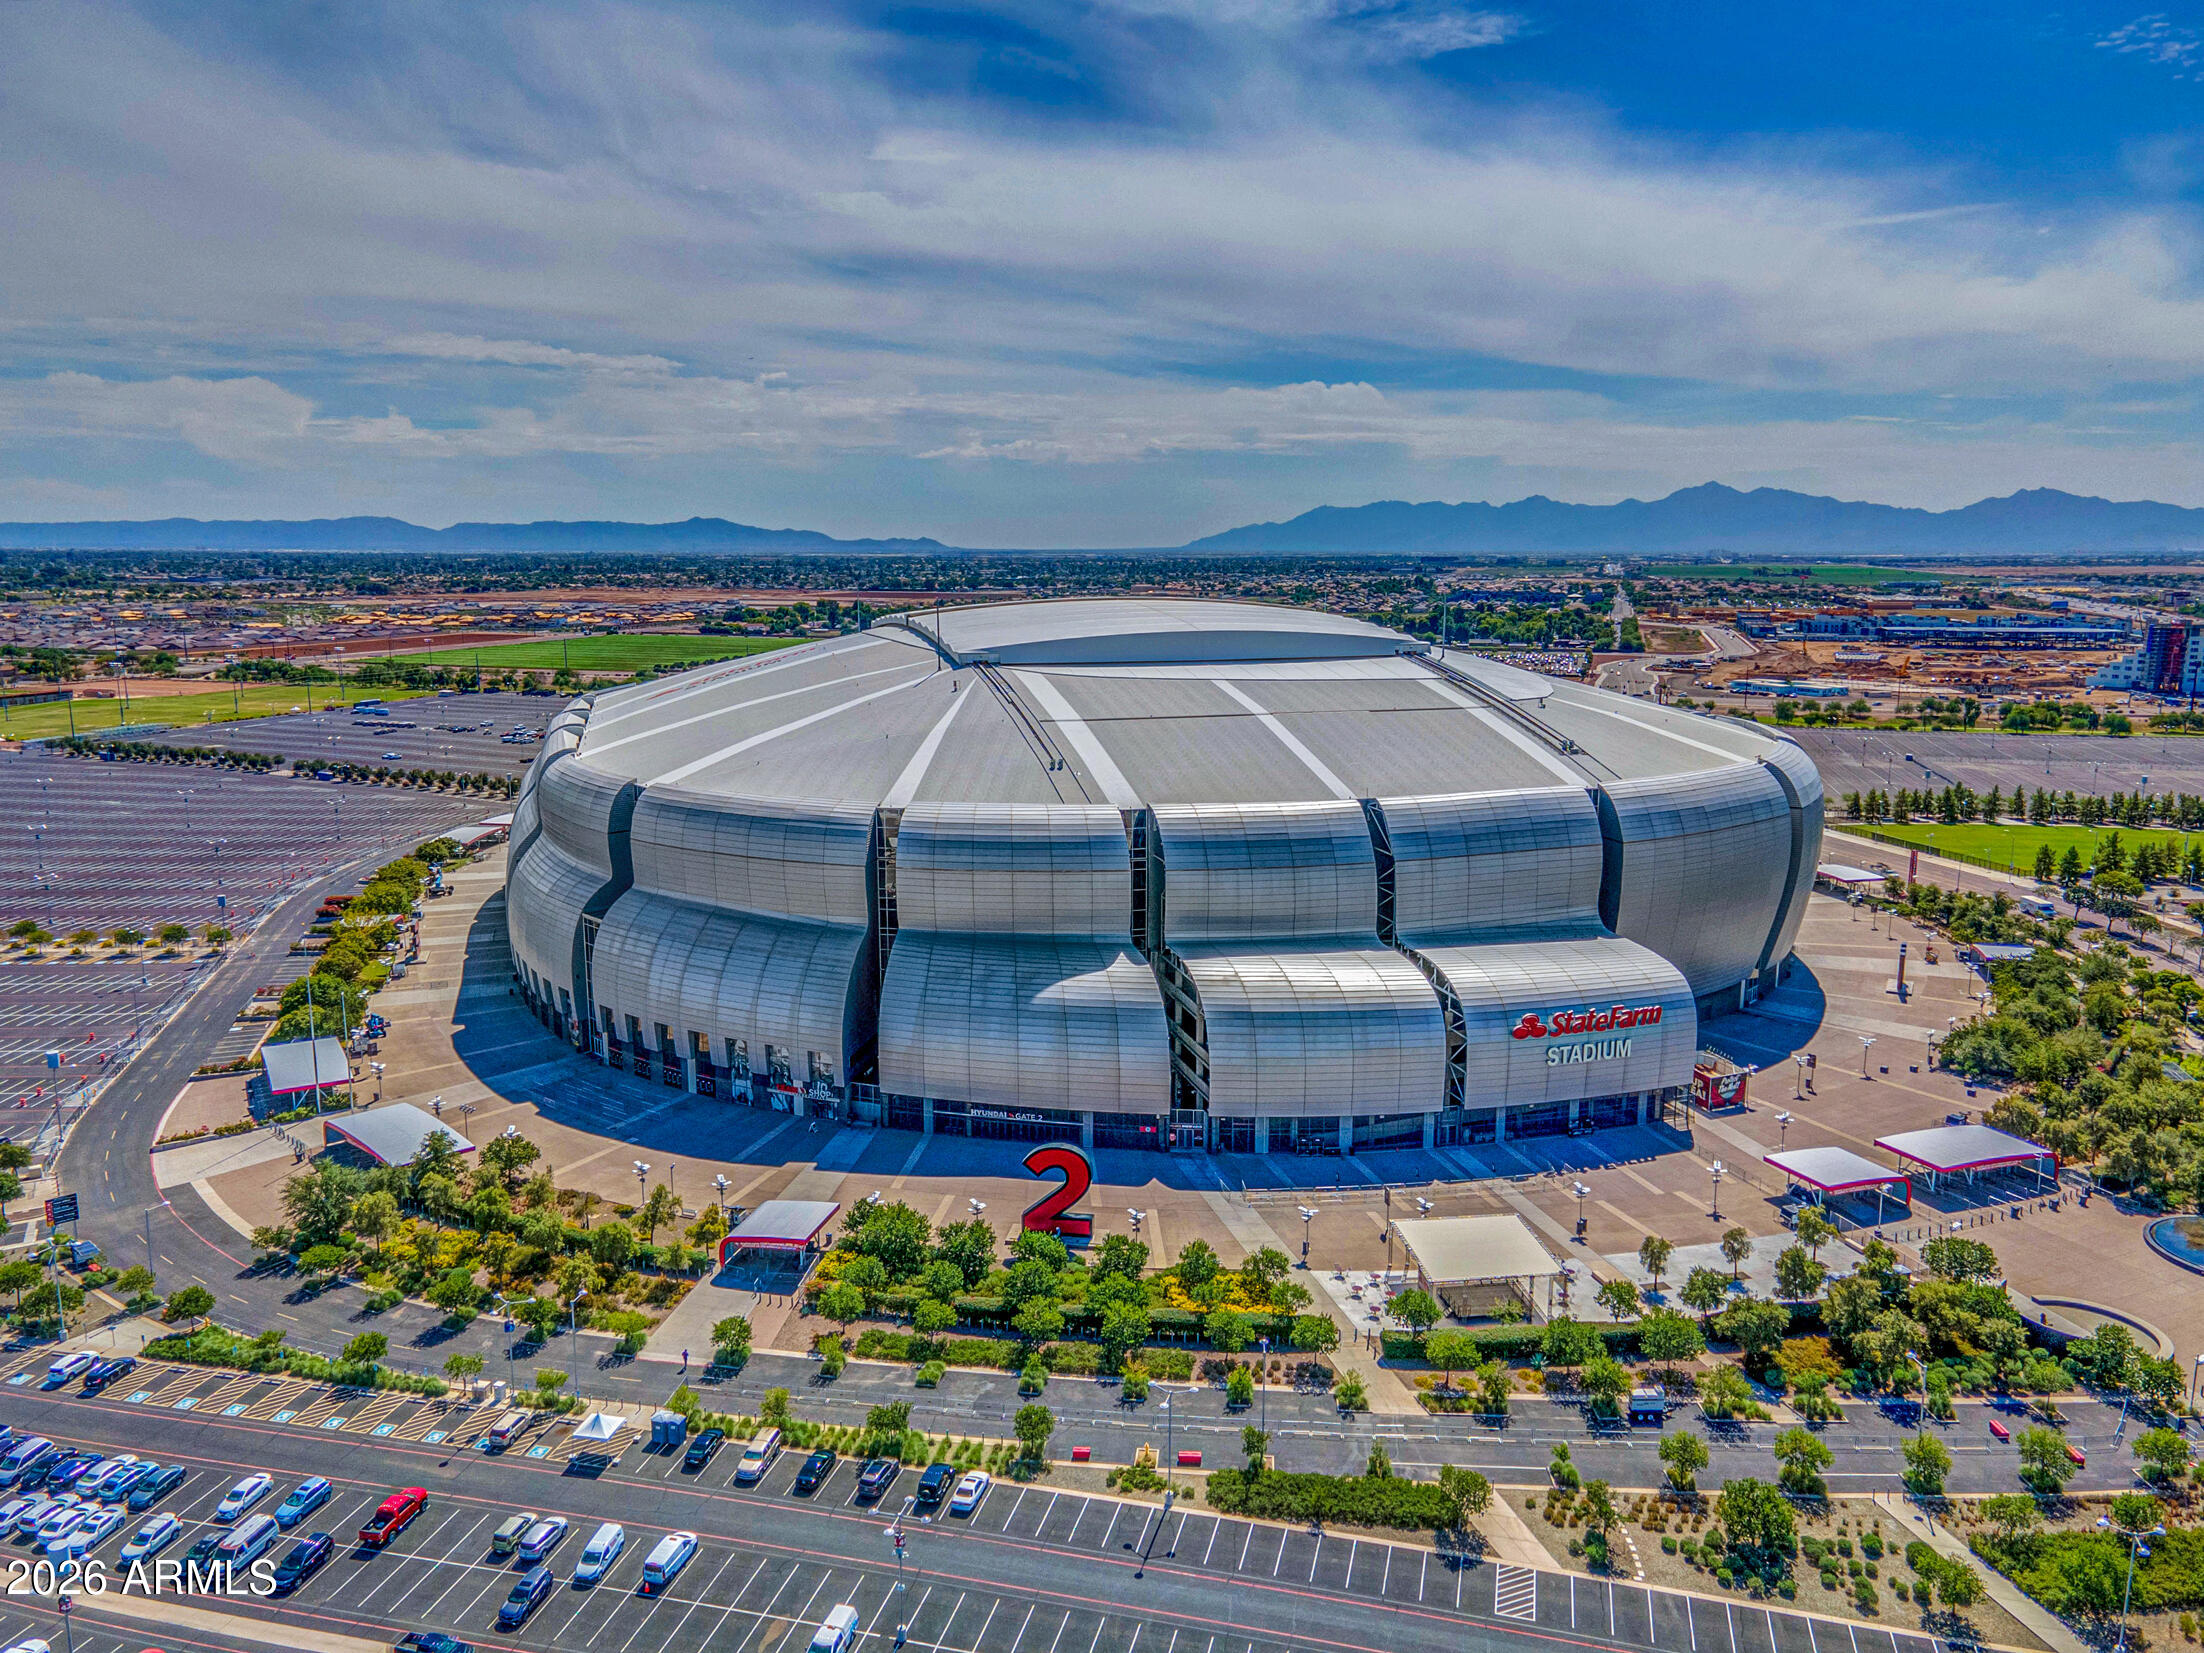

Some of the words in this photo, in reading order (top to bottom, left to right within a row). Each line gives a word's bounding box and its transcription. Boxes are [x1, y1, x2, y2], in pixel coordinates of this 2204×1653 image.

[1547, 1039, 1632, 1066] STADIUM
[808, 1088, 831, 1100] SHOP
[971, 1109, 1007, 1118] HYUNDAI
[1015, 1112, 1036, 1121] GATE
[1021, 1142, 1095, 1238] 2
